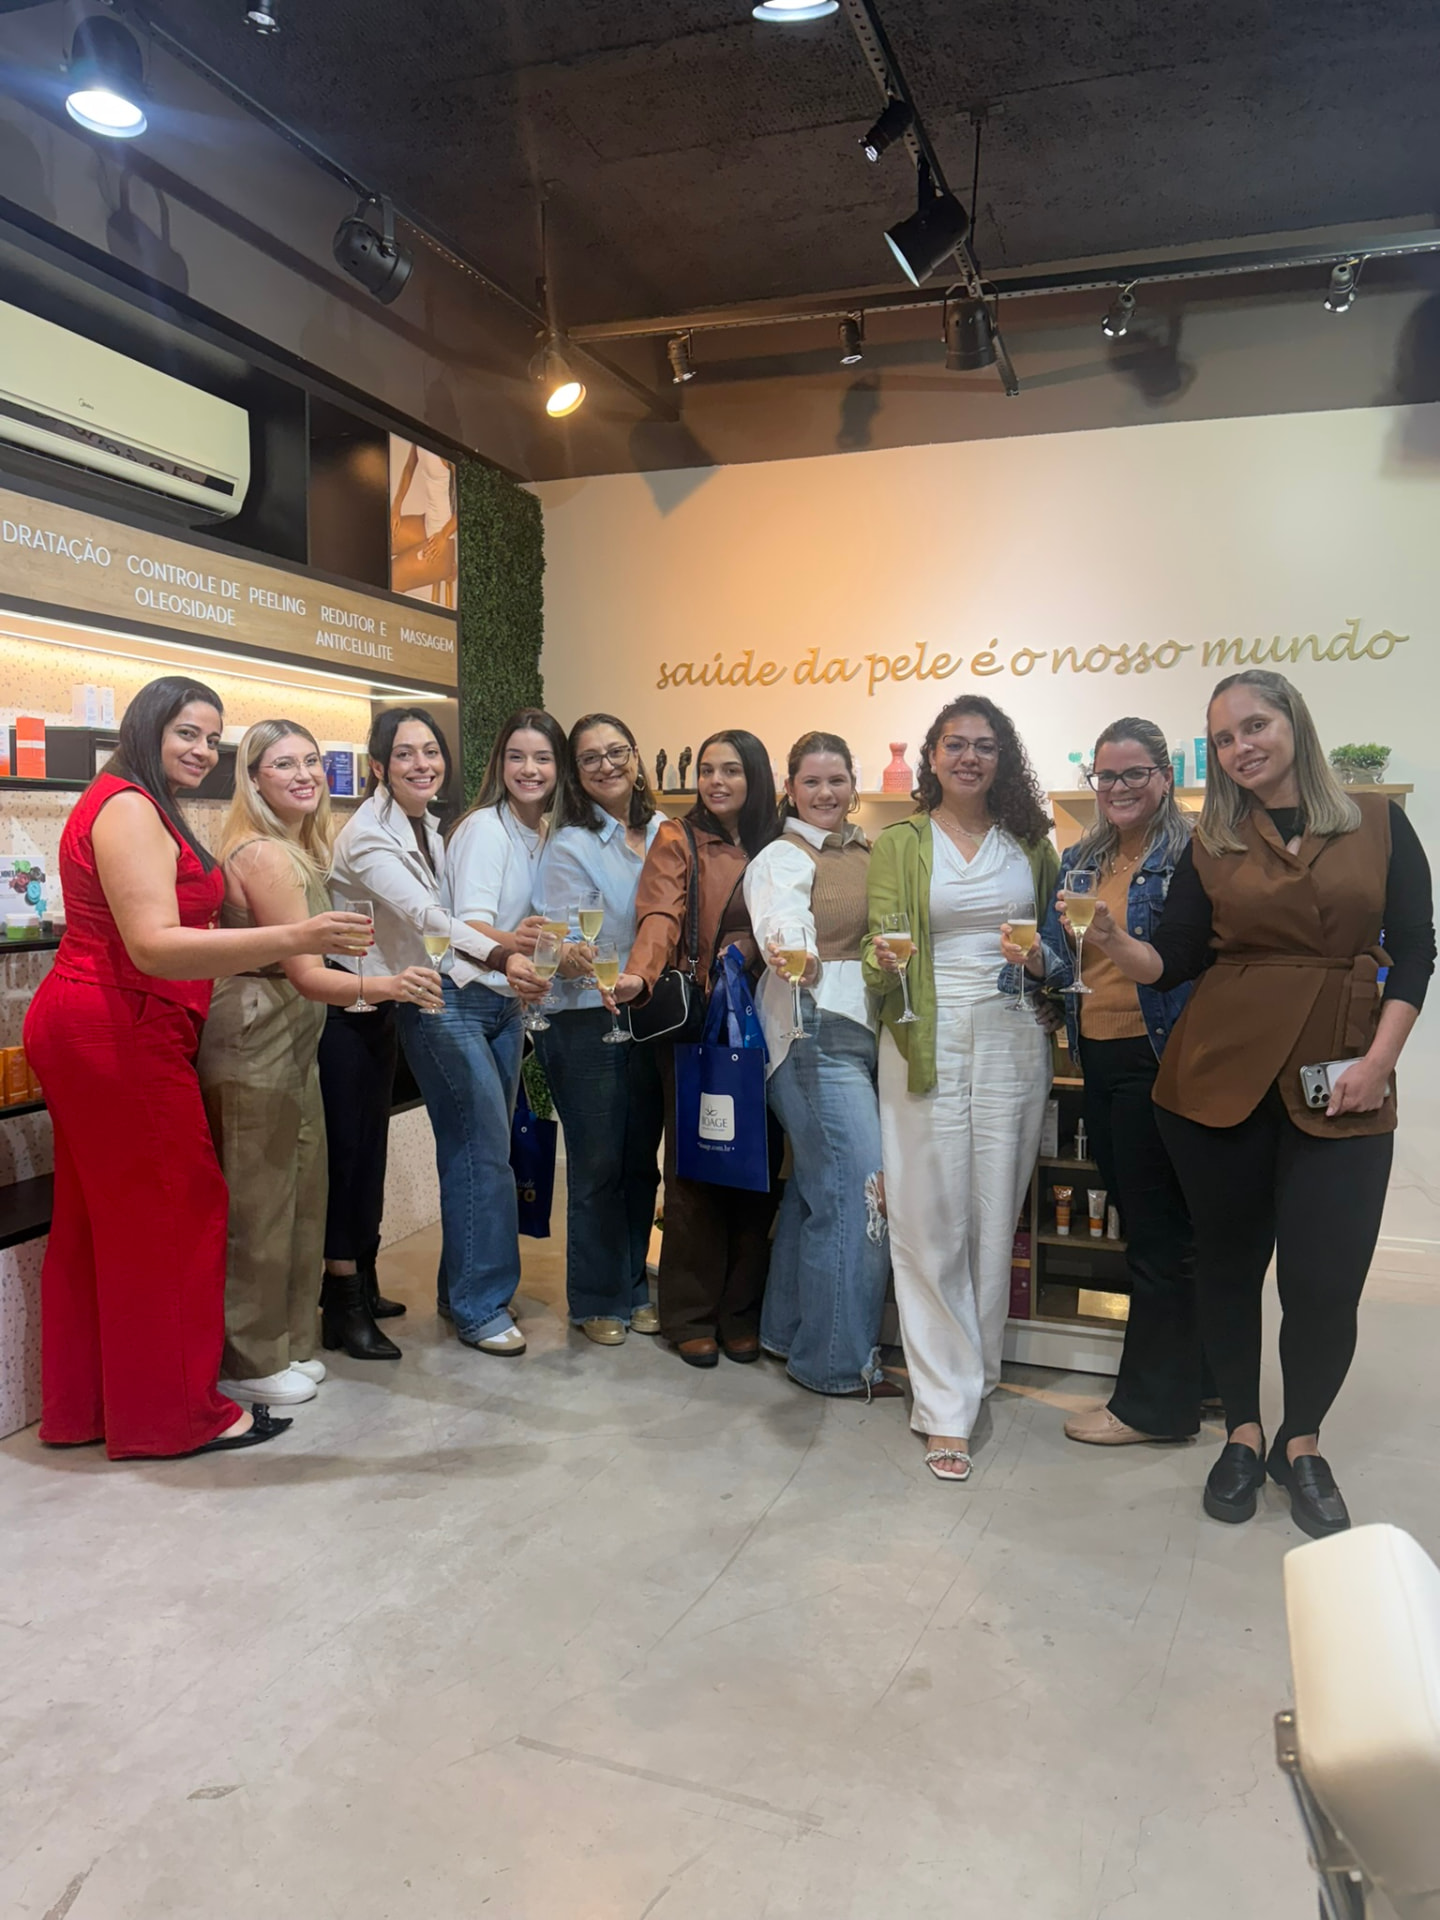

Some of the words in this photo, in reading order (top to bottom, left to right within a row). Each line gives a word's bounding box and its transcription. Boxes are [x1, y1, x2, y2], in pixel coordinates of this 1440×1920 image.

[2, 520, 112, 567] DRATAÇÃO
[126, 555, 218, 595] CONTROLE
[220, 579, 241, 600] DE
[134, 586, 237, 627] OLEOSIDADE
[249, 587, 307, 616] PEELING
[320, 605, 375, 635] REDUTOR
[379, 621, 388, 637] E
[315, 630, 395, 662] ANTICELULITE
[400, 627, 455, 653] MASSAGEM
[656, 650, 787, 690] saúde
[793, 647, 862, 684] da
[865, 641, 963, 697] pele
[970, 637, 1004, 676] é
[1010, 646, 1047, 676] o
[1052, 639, 1195, 675] nosso
[1201, 617, 1410, 667] mundo
